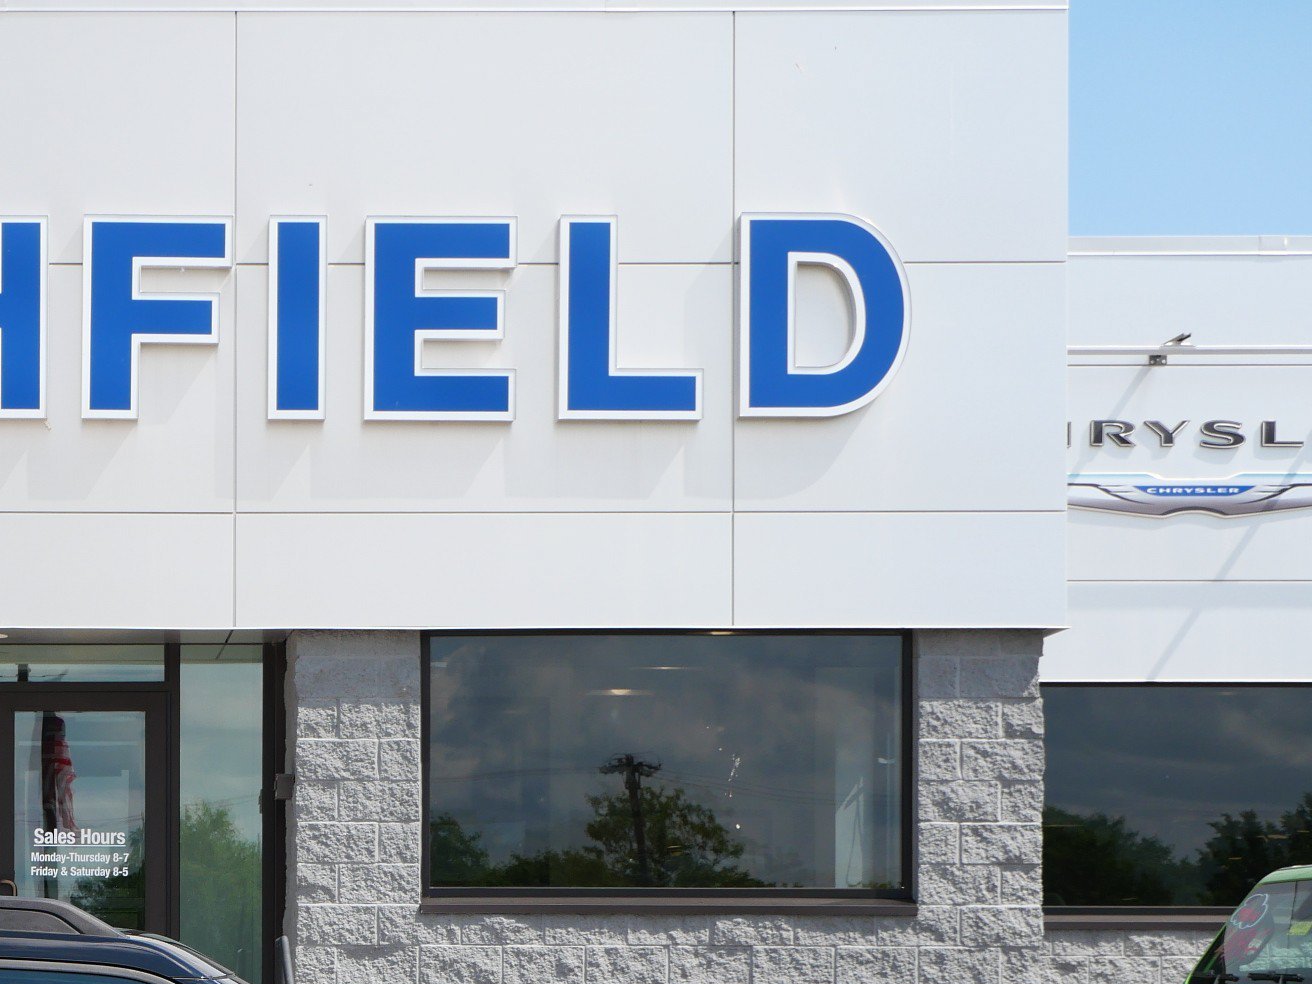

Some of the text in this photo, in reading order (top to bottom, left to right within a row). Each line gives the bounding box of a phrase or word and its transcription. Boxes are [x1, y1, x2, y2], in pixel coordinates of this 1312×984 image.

[1067, 419, 1304, 450] RYSL
[1147, 487, 1239, 495] CHRYSLER
[33, 828, 126, 845] Sales Hours
[30, 852, 130, 864] Monday-Thursday 8-7
[30, 866, 129, 878] Friday & Saturday 8-5
